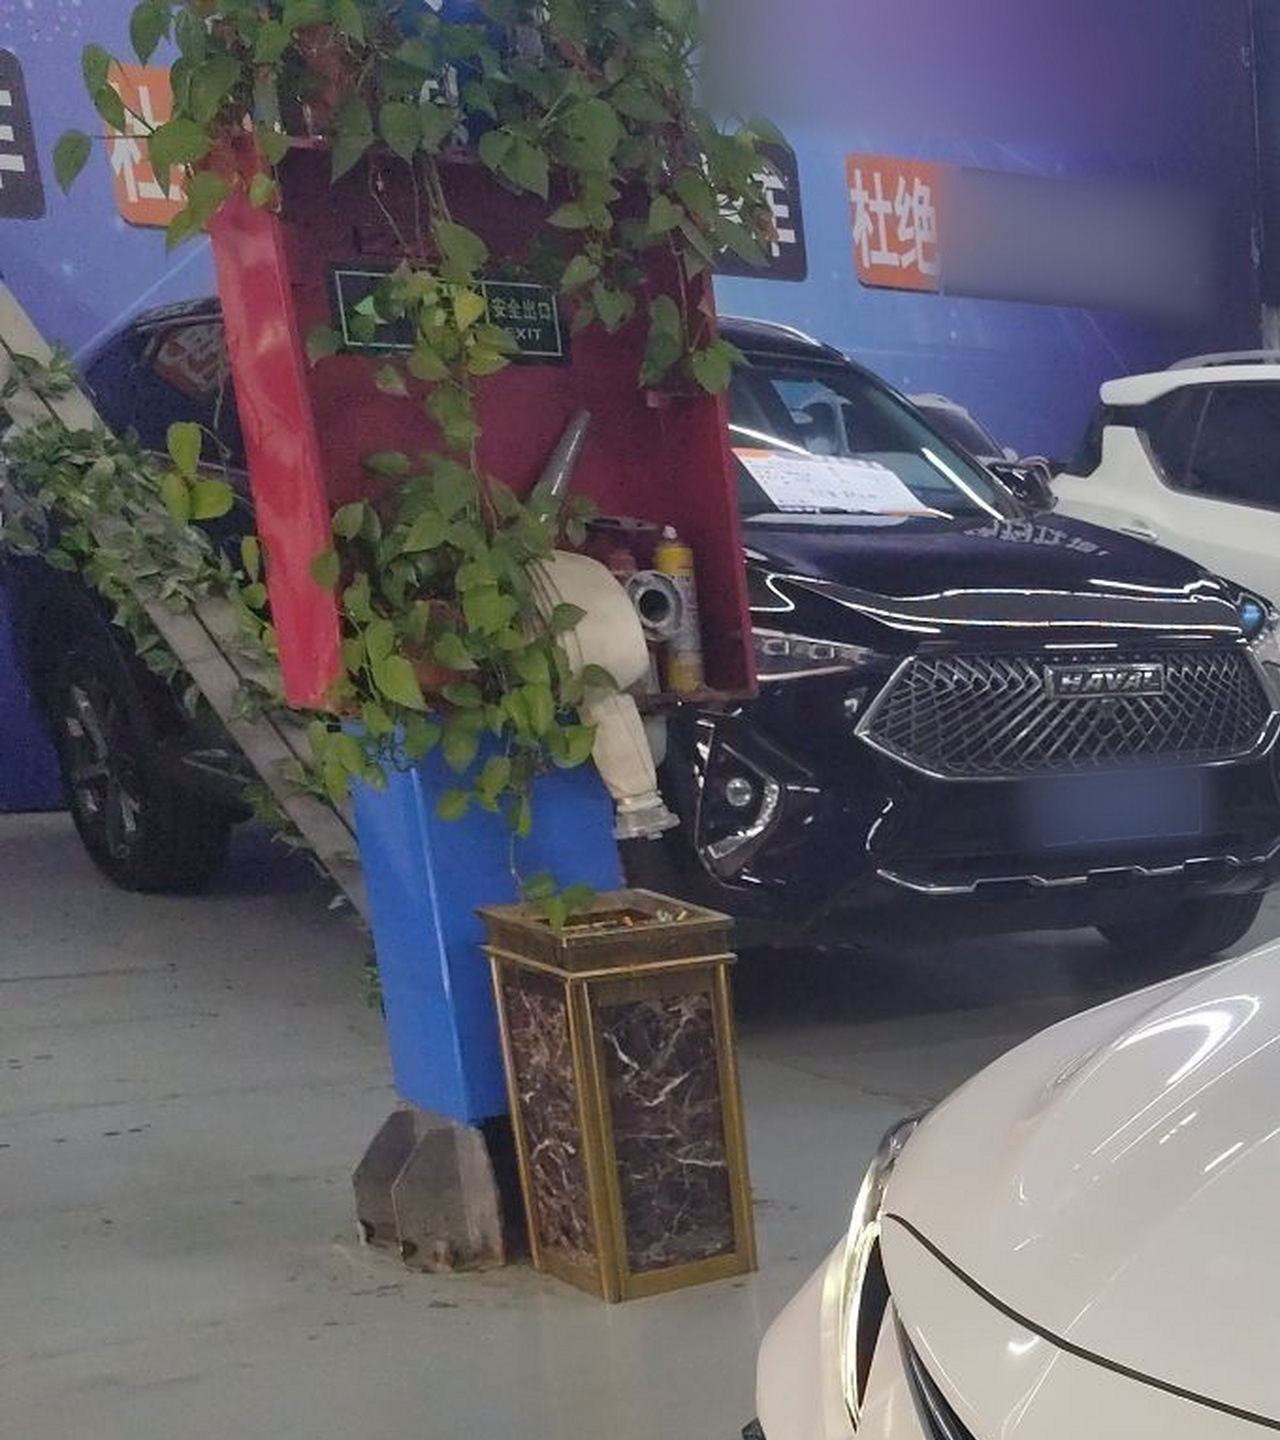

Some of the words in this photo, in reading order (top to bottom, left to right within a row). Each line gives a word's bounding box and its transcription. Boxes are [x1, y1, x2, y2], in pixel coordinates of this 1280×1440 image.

[491, 298, 551, 321] 安全出口
[1059, 672, 1160, 692] HAVAL
